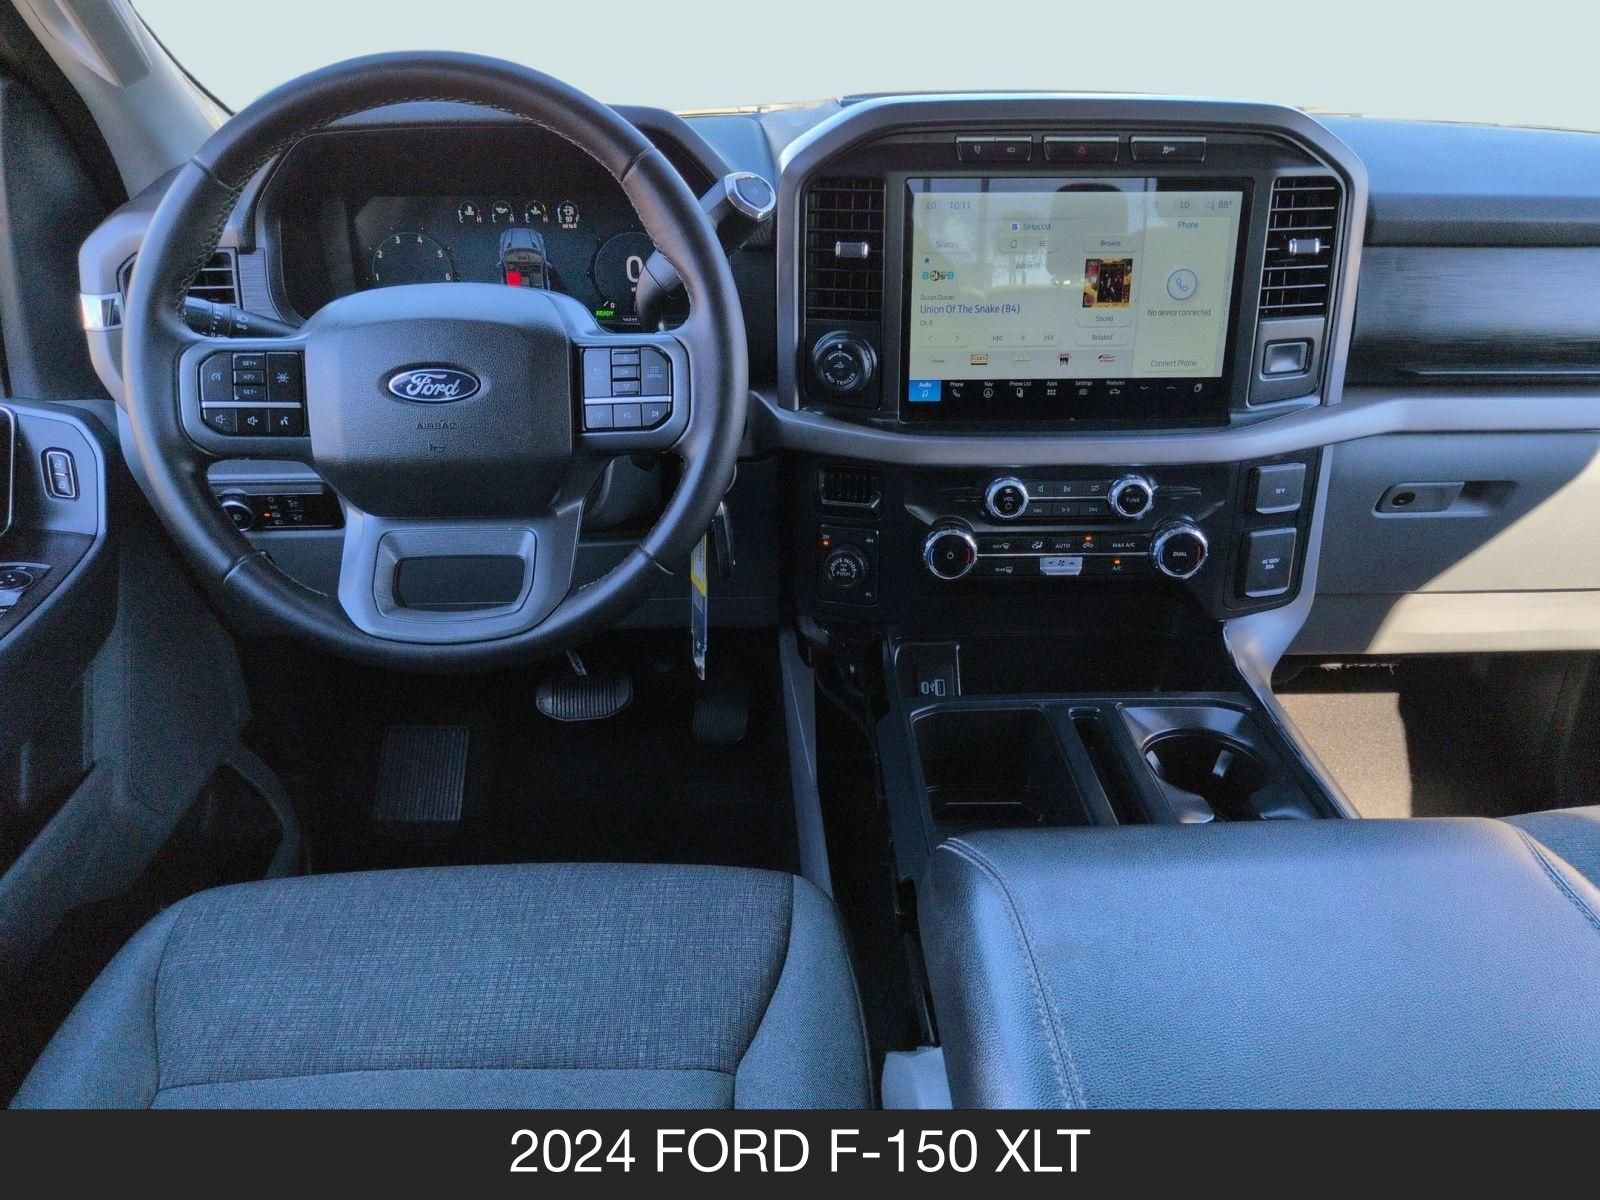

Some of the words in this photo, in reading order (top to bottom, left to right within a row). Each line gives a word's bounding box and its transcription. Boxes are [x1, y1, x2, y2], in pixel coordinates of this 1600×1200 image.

[949, 201, 971, 210] 10:11
[1177, 221, 1199, 229] Phone
[395, 236, 401, 244] 3
[417, 236, 423, 244] 4
[1100, 239, 1121, 247] Browse
[377, 250, 384, 259] 2
[437, 250, 443, 258] 5
[626, 255, 644, 283] 0
[445, 272, 451, 281] 6
[920, 305, 944, 314] Union
[946, 305, 956, 314] Of
[959, 305, 974, 314] The
[975, 305, 1000, 314] Snake
[1001, 304, 1020, 315] (84)
[1157, 309, 1178, 317] device
[1178, 309, 1211, 317] connected
[1095, 314, 1114, 322] Sound
[1150, 359, 1176, 367] Connect
[1177, 359, 1198, 367] Phone
[836, 372, 856, 385] TRAILER
[406, 373, 460, 398] Ford
